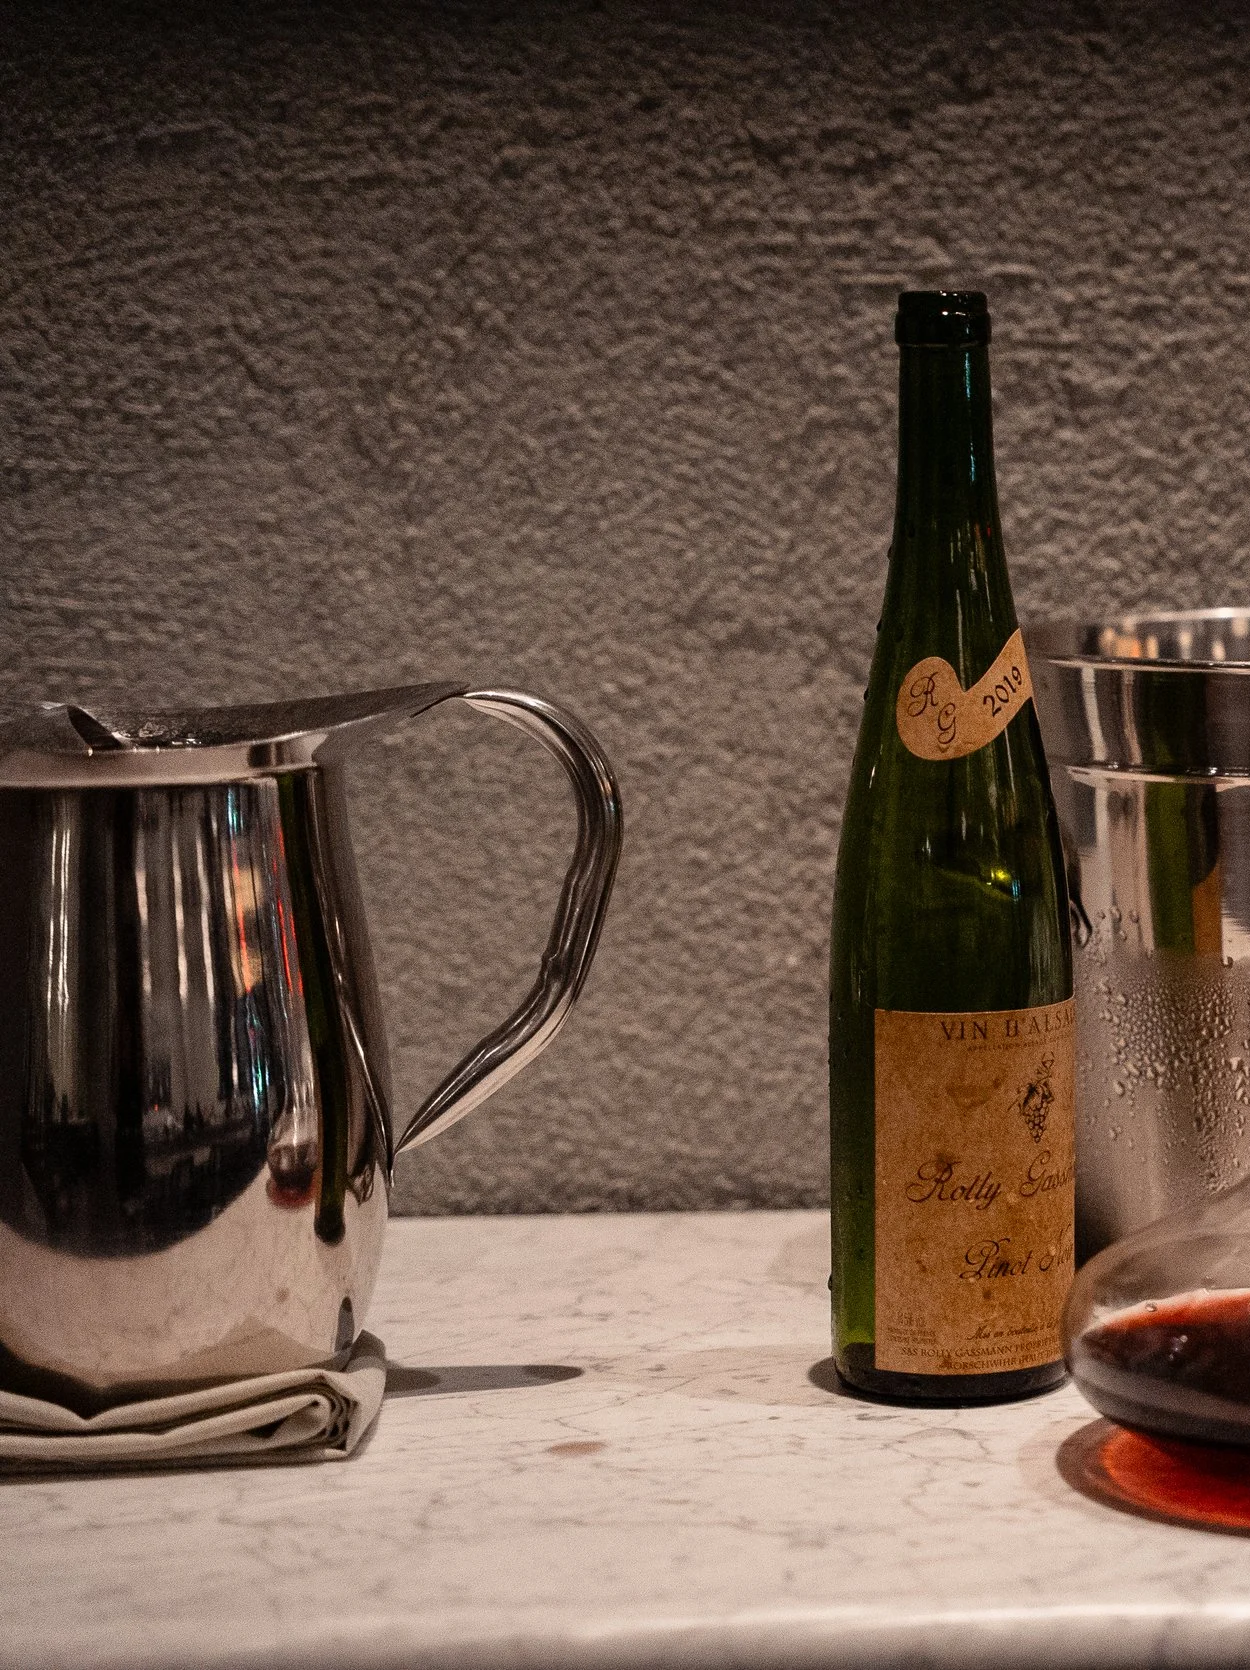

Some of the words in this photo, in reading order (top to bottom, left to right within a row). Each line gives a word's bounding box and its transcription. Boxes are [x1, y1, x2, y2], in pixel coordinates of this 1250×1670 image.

[906, 671, 939, 718] R
[983, 666, 1023, 718] 2019
[937, 702, 957, 745] G
[940, 1020, 988, 1040] VIN
[905, 1159, 1002, 1211] Rolly
[959, 1237, 1033, 1280] Pinot
[954, 1345, 1013, 1359] GASSMANN
